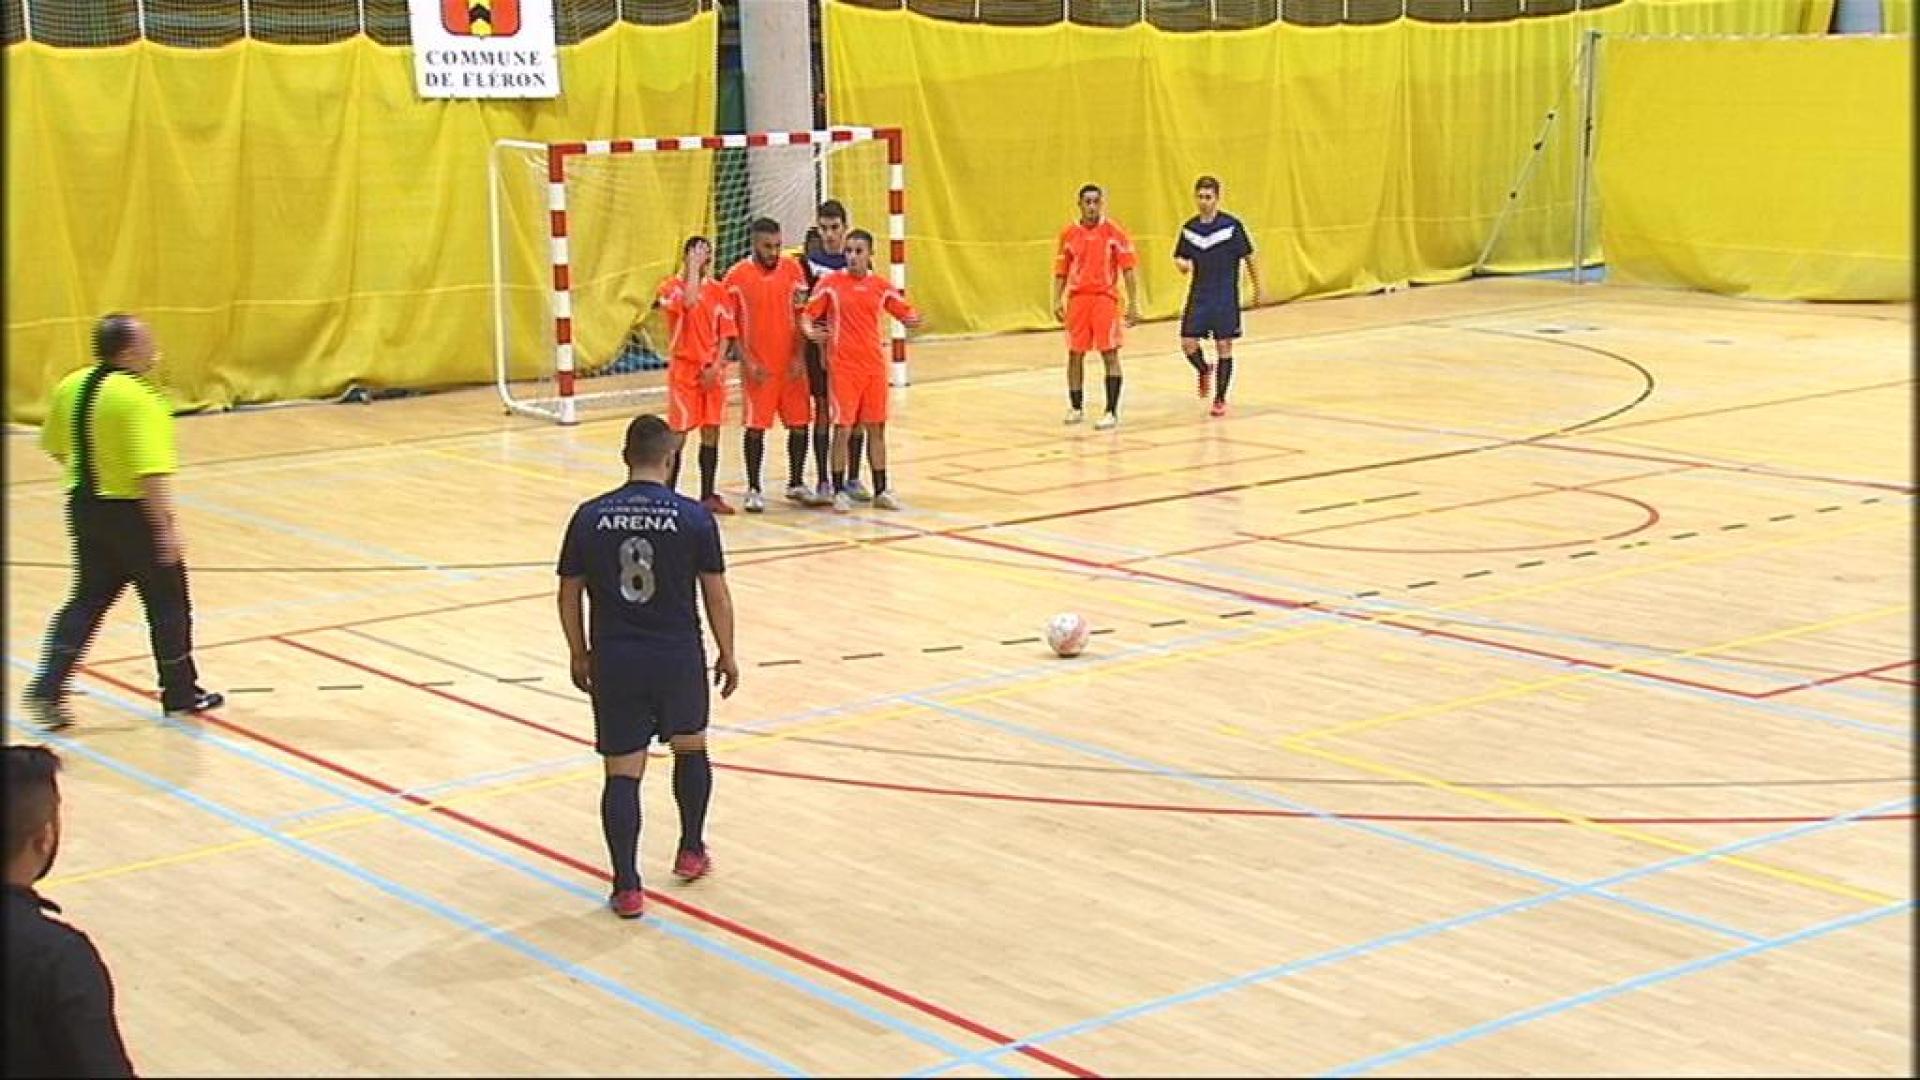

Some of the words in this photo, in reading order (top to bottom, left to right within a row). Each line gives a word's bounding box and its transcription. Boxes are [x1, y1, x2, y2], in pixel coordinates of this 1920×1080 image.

[426, 49, 542, 66] COMMUNE
[425, 72, 455, 87] DE
[463, 69, 546, 87] FLÉRON
[597, 515, 678, 532] ARENA
[619, 537, 655, 603] 8
